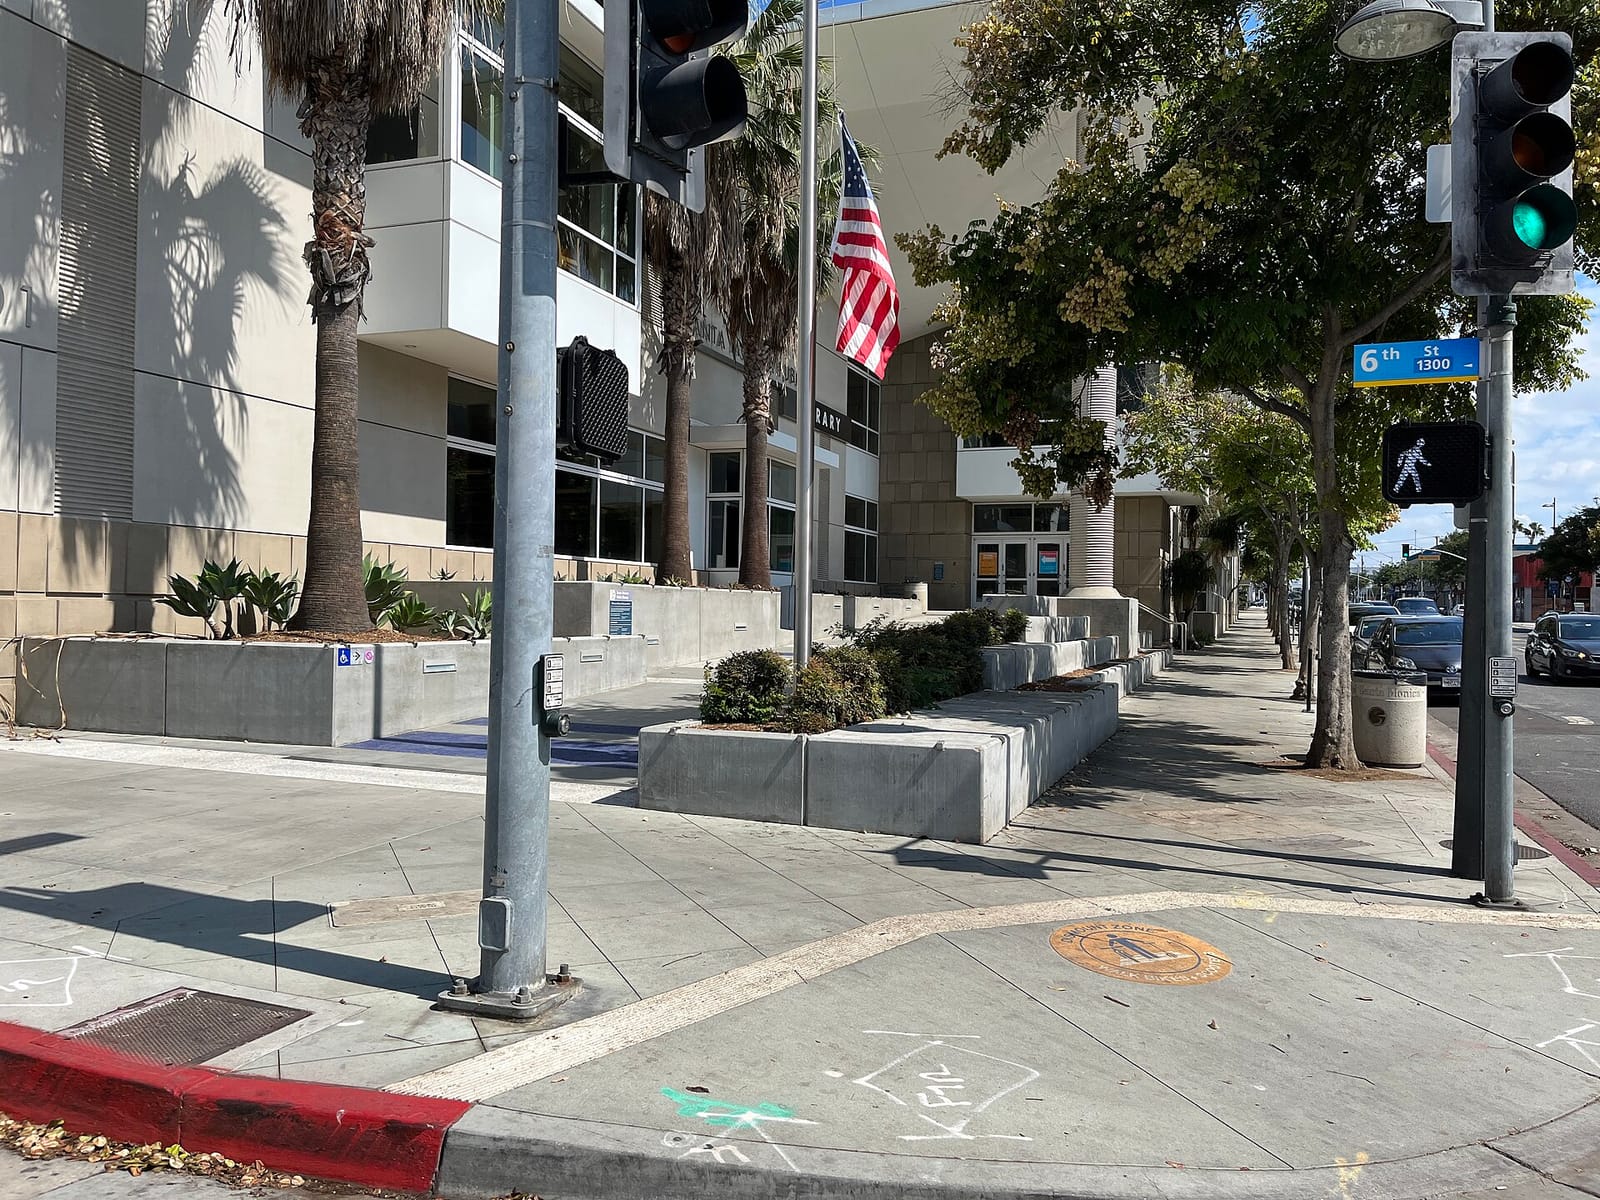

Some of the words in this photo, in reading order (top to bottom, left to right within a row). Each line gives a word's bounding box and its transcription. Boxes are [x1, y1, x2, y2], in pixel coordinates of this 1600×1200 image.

[1424, 345, 1440, 357] St
[1416, 358, 1450, 371] 1300
[815, 407, 841, 433] RARY
